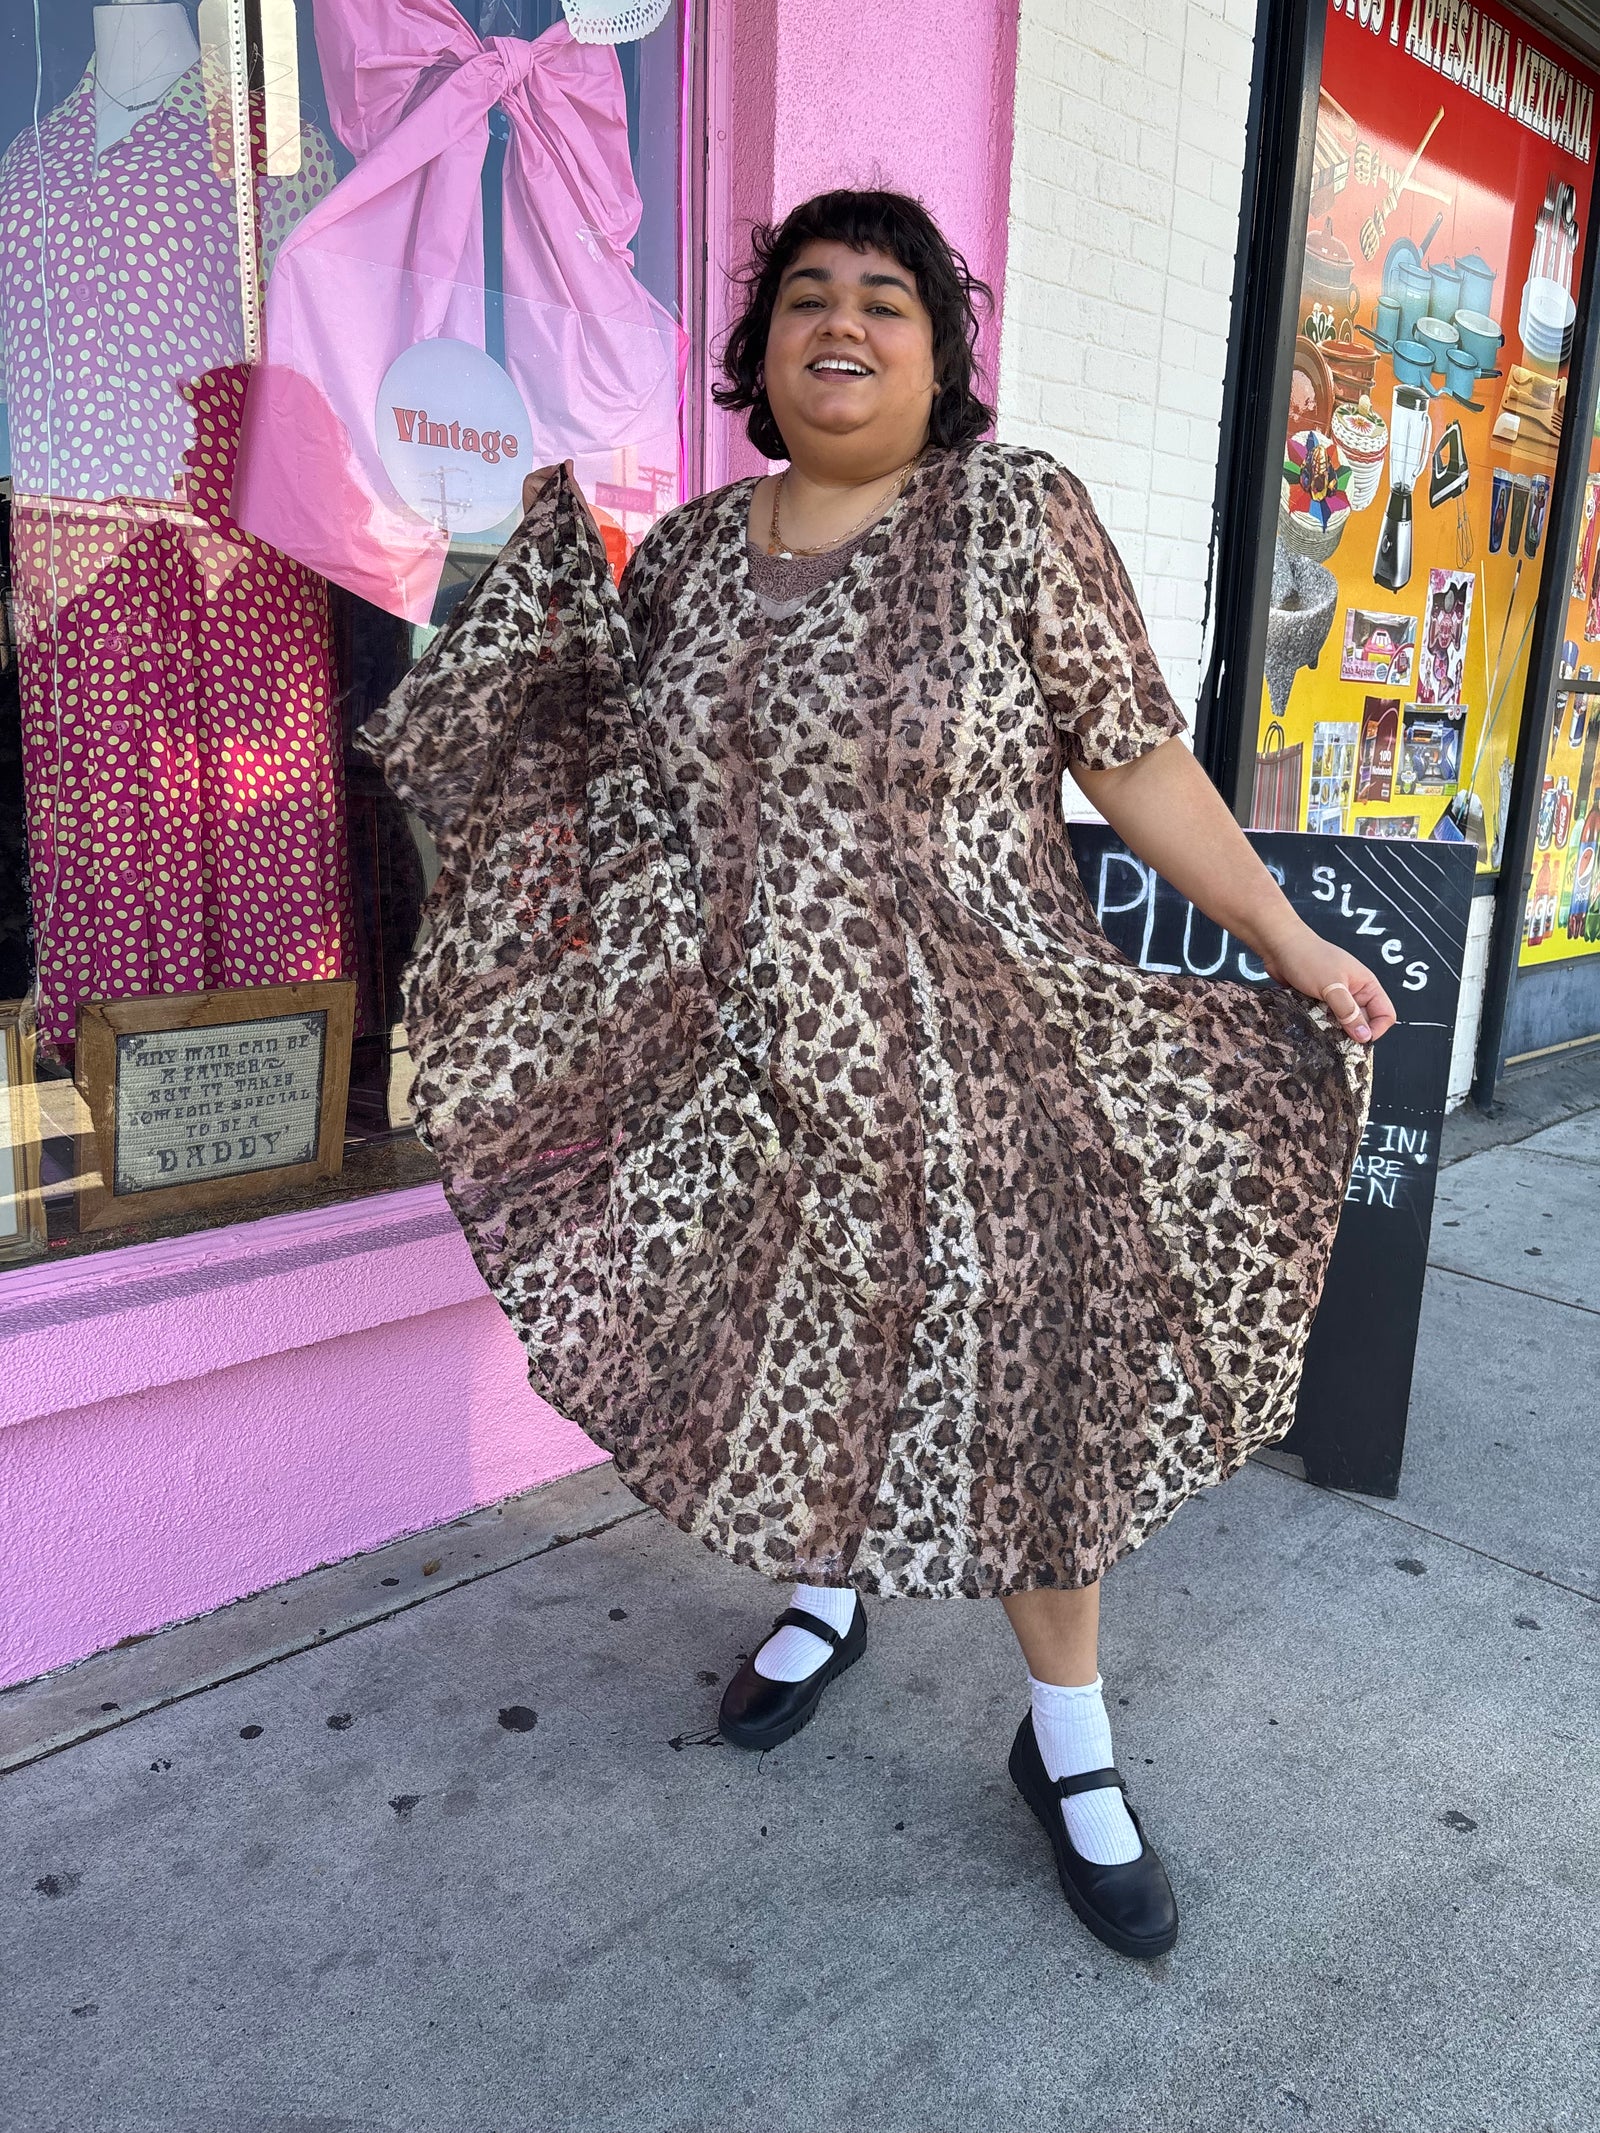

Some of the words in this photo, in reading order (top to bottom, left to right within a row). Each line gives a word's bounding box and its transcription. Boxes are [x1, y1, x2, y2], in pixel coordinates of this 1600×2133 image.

[1404, 0, 1510, 113] ARTESANIA
[1508, 38, 1594, 164] MEXICANA
[391, 406, 519, 464] Vintage
[1379, 750, 1392, 762] 100
[1312, 866, 1430, 991] Sizes
[185, 1043, 229, 1061] MAN
[238, 1039, 278, 1056] CAN
[286, 1034, 310, 1049] BE
[150, 1086, 191, 1104] BUT
[186, 1124, 209, 1138] TO
[218, 1118, 241, 1132] BE
[1352, 1154, 1405, 1179] ARE
